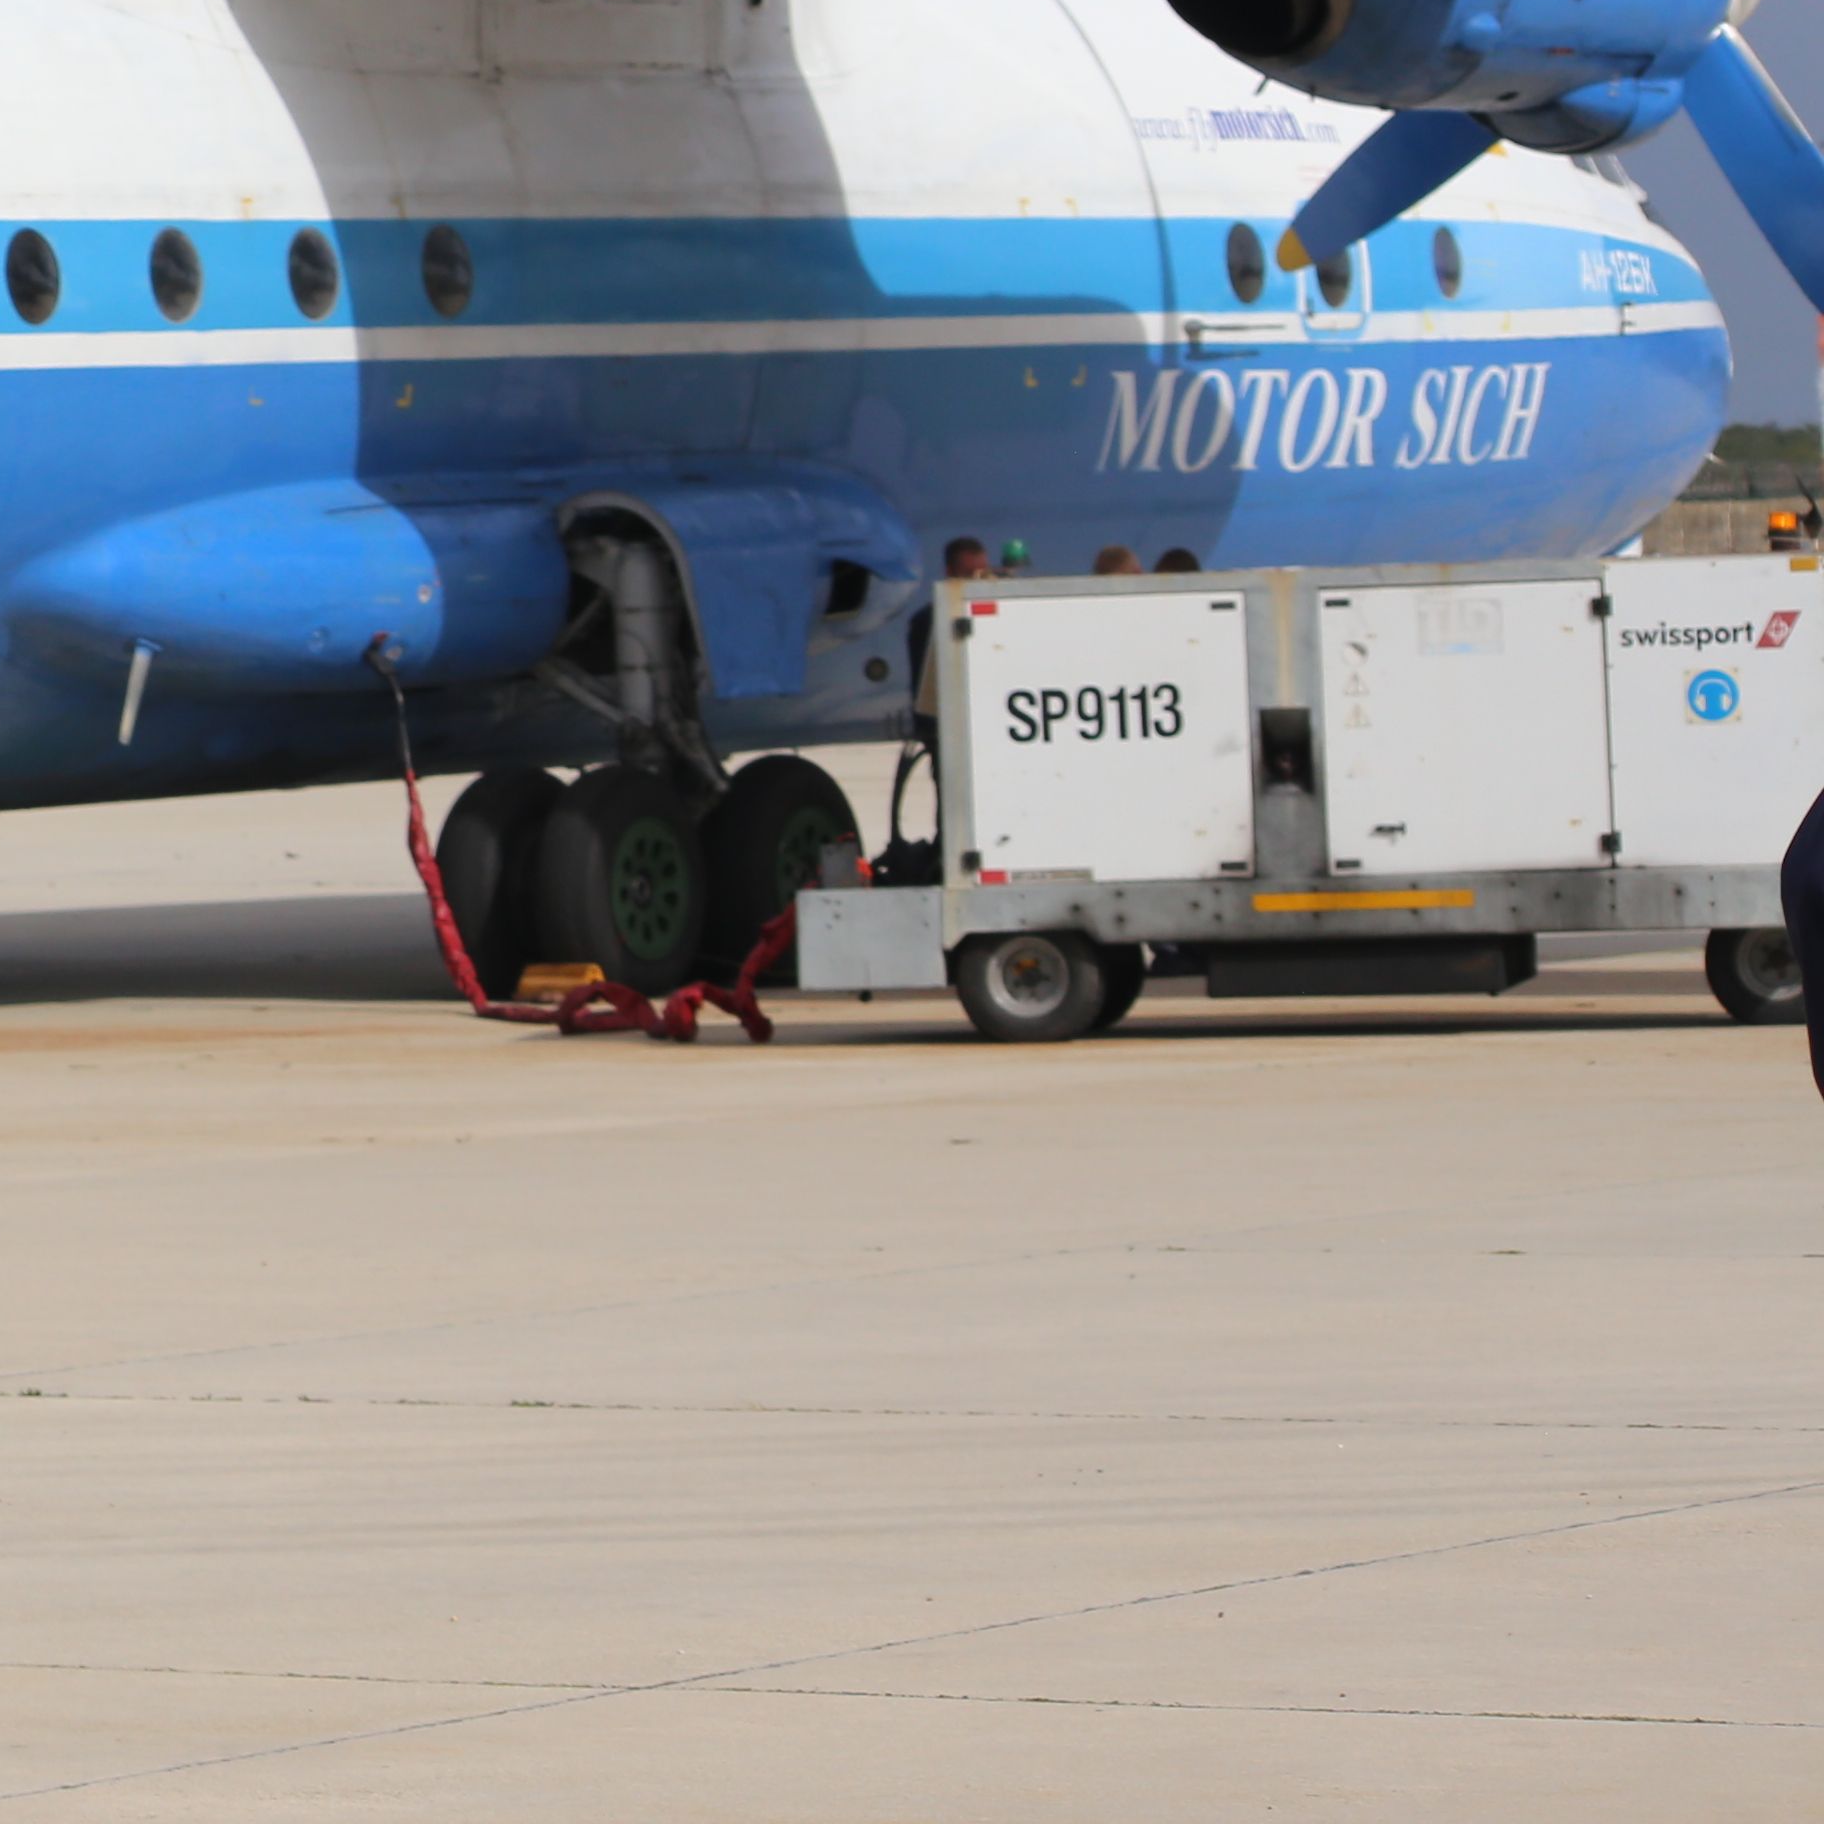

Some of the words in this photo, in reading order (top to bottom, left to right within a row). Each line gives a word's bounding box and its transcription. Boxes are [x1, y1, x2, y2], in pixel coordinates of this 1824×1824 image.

[1096, 367, 1388, 474] MOTOR
[1394, 362, 1550, 469] SICH
[1620, 622, 1754, 651] swissport
